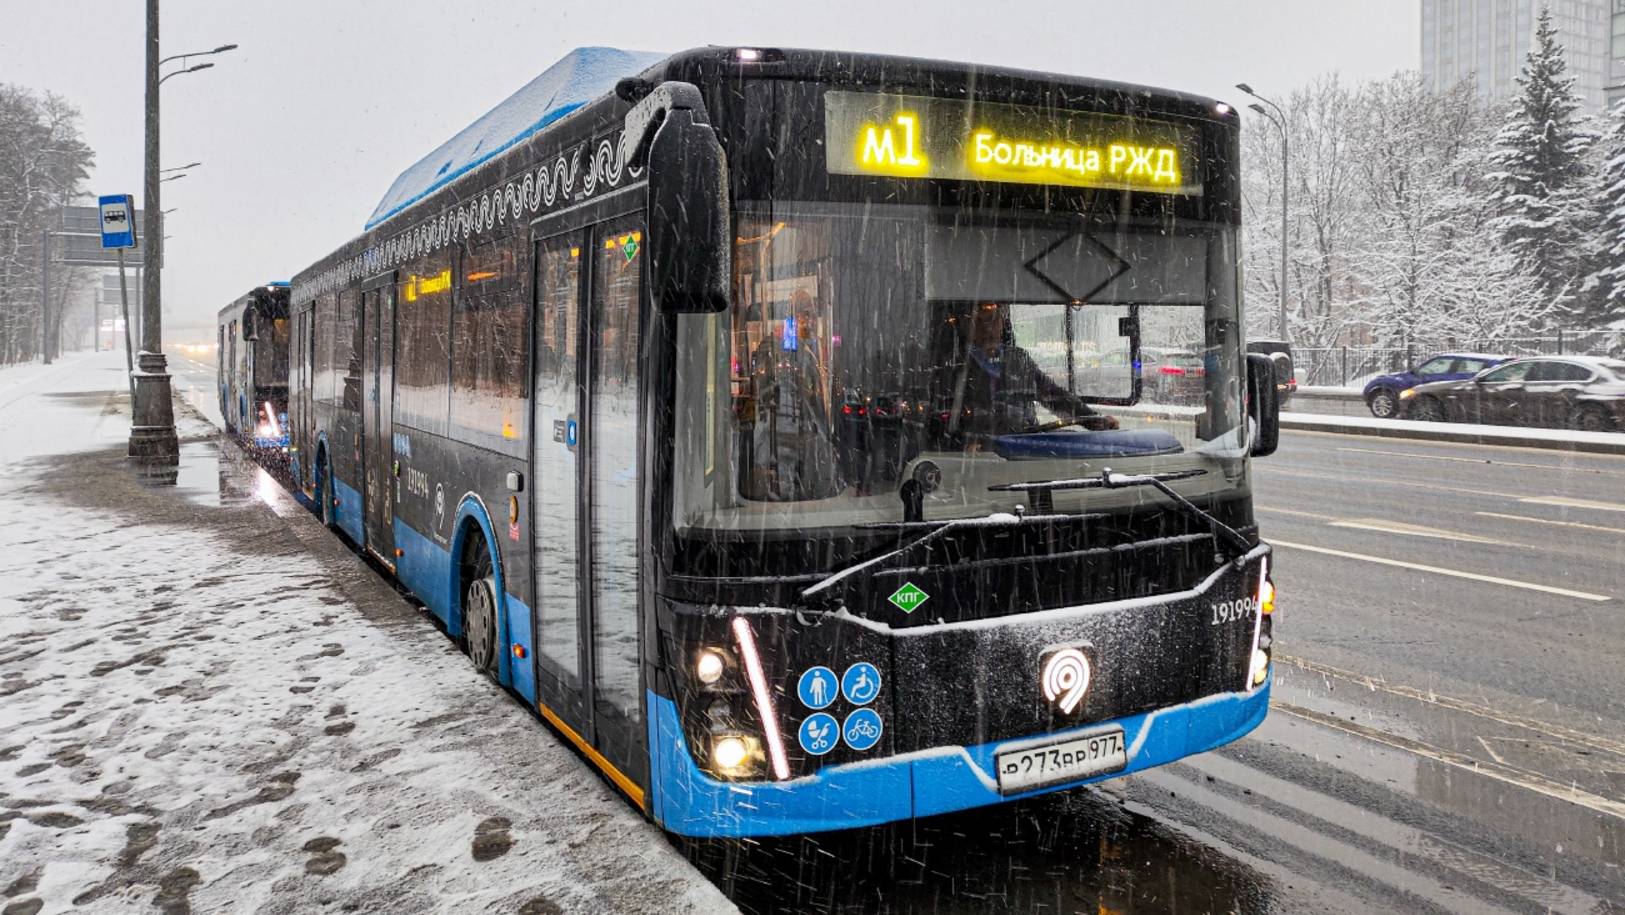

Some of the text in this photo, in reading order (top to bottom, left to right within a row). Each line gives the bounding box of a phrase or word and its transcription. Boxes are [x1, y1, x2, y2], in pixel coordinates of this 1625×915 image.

[975, 133, 1100, 175] Больница
[1110, 143, 1176, 183] РЖД
[896, 592, 920, 603] КПГ
